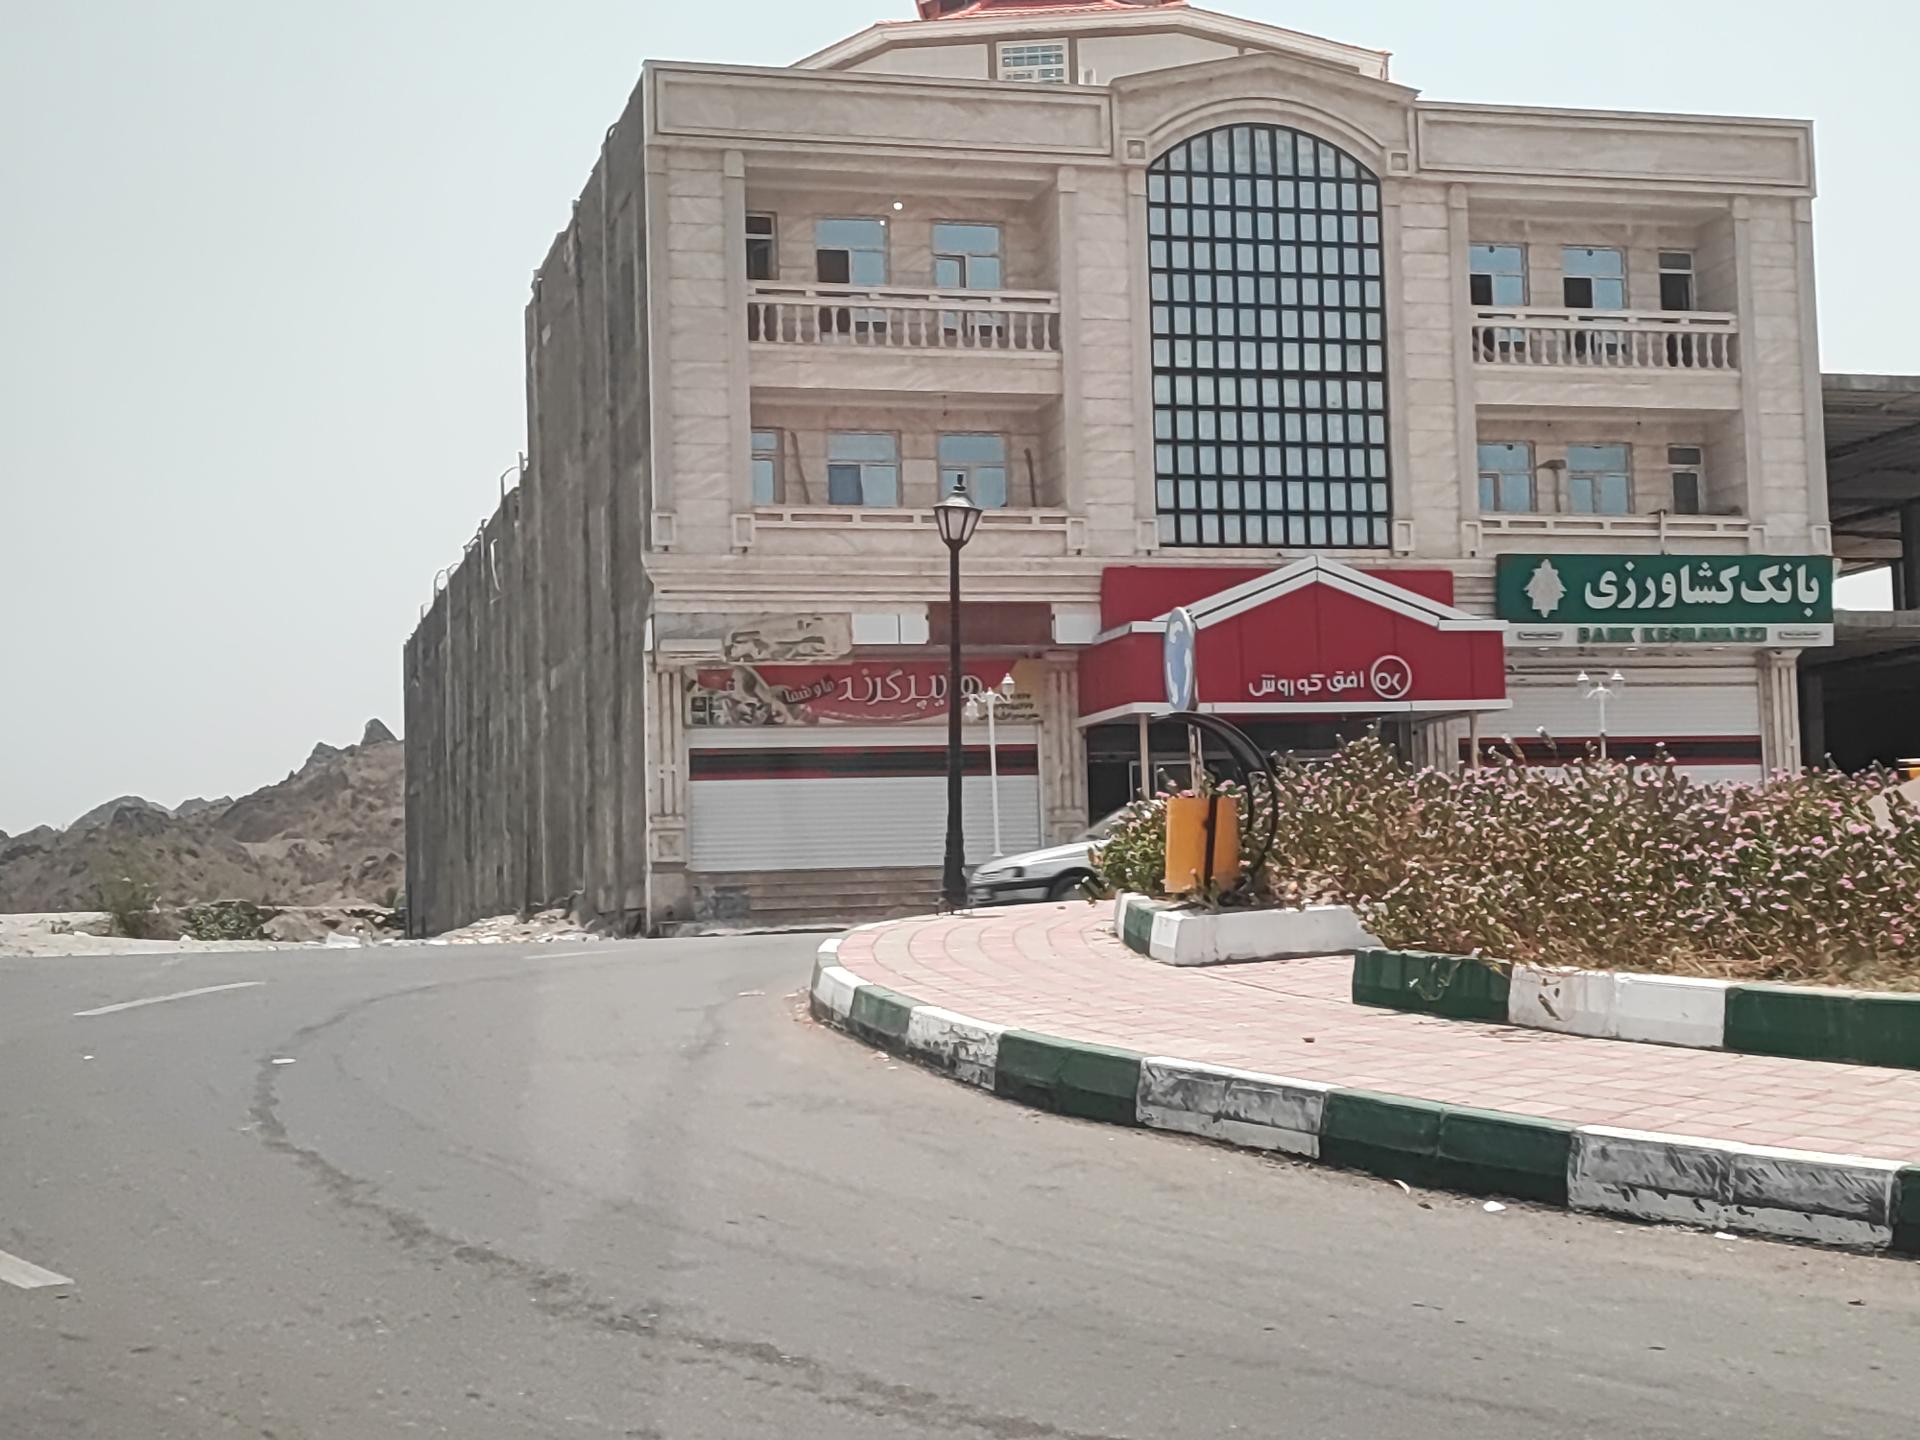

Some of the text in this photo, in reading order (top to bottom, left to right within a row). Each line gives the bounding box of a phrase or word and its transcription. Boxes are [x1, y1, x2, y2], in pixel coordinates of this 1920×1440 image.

[1584, 561, 1820, 618] بانک کشاورزی
[1248, 670, 1365, 697] افق کوروش
